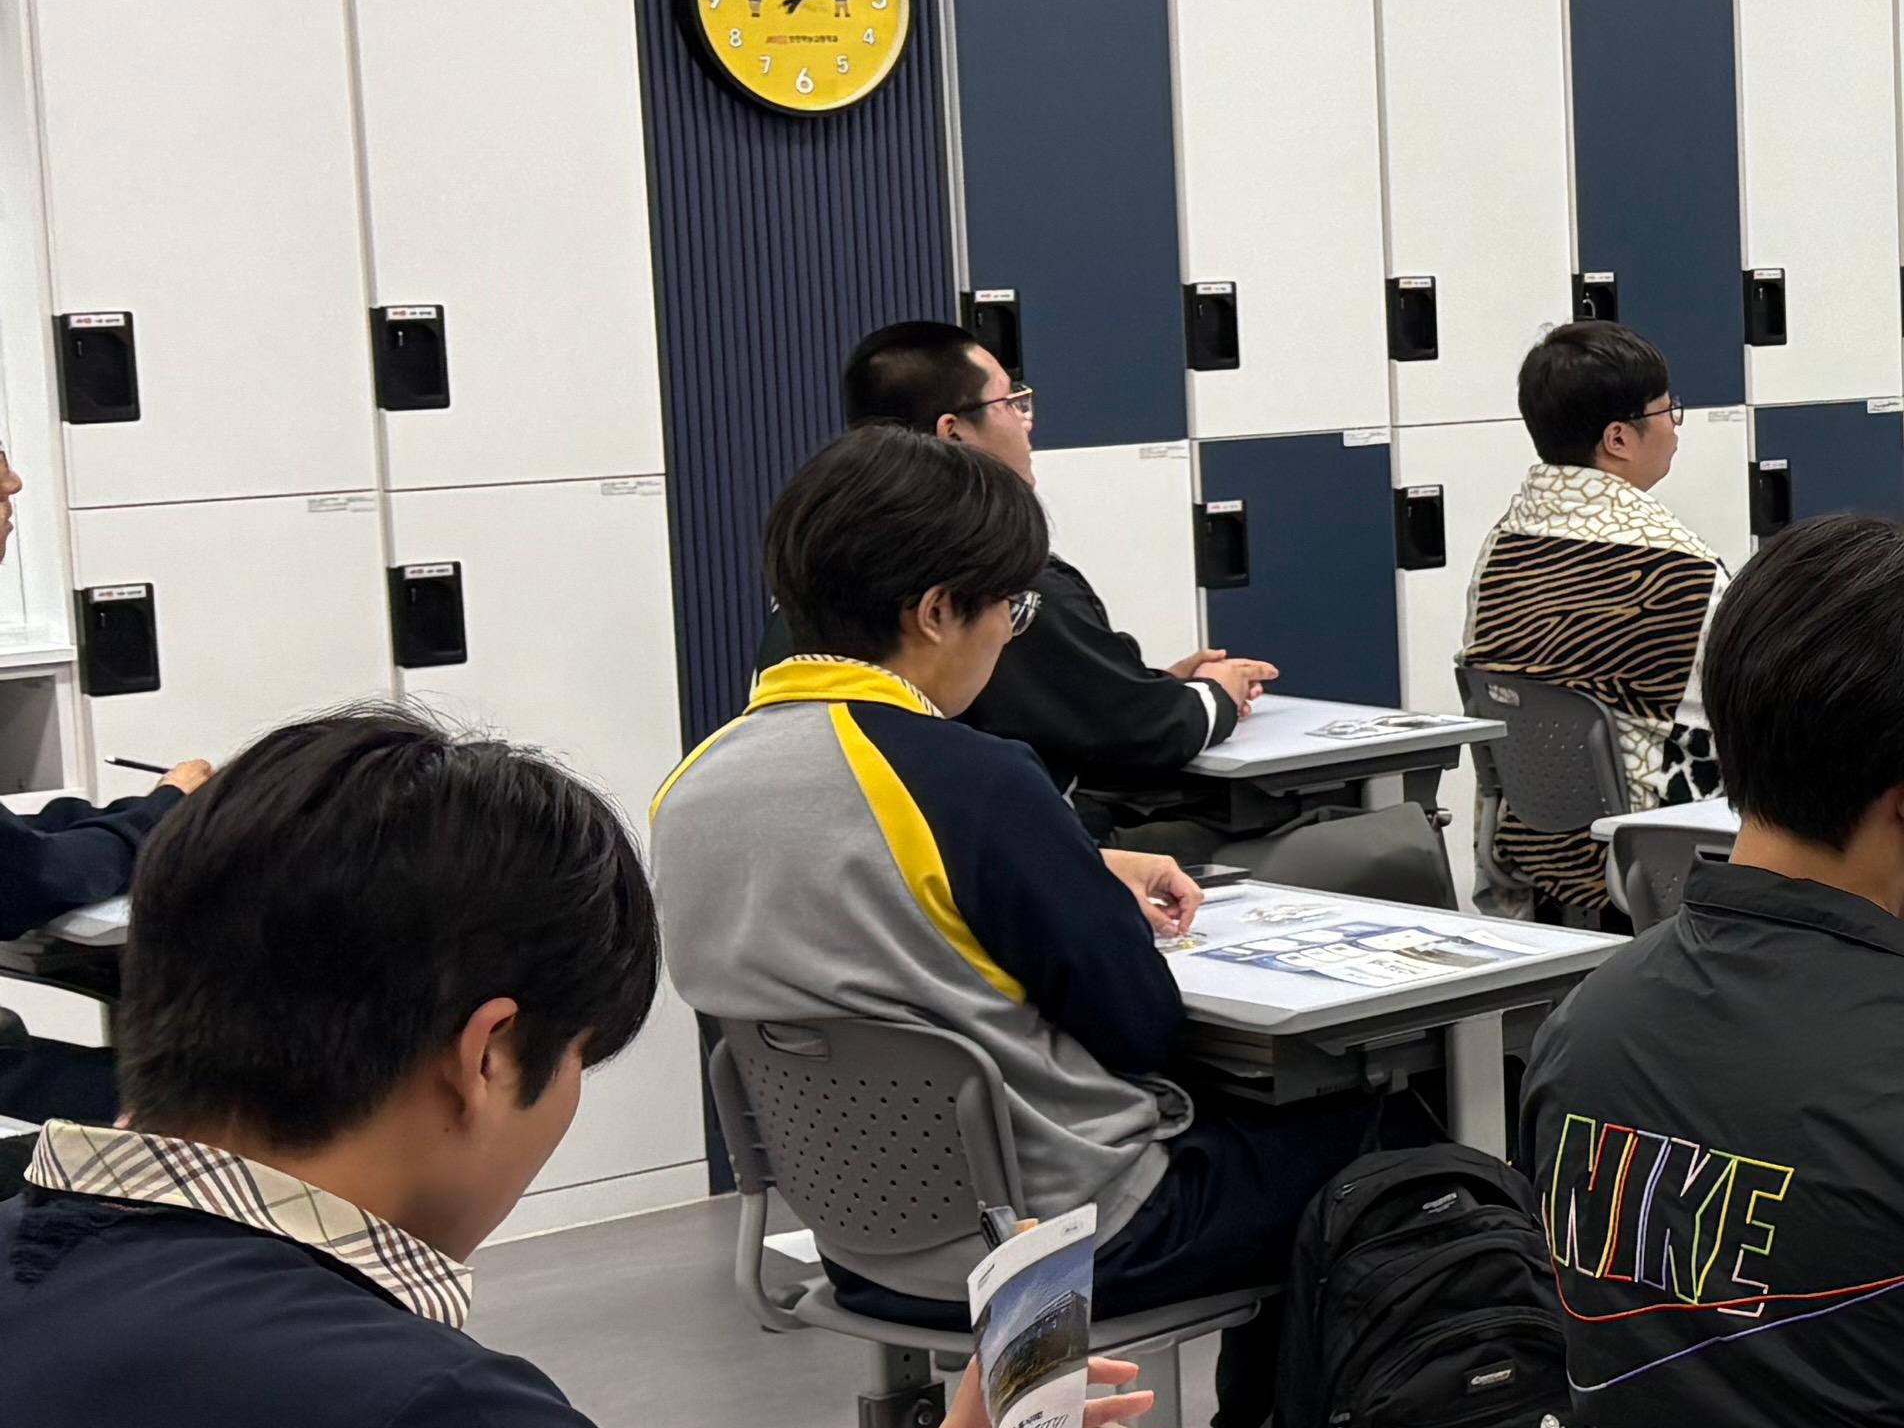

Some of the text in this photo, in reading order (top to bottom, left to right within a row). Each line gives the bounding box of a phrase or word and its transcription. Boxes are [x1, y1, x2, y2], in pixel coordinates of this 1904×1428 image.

[728, 28, 743, 47] 8
[863, 27, 876, 46] 4
[759, 56, 772, 74] 7
[836, 56, 849, 73] 5
[795, 67, 814, 94] 6
[1550, 1113, 1795, 1317] NIKE
